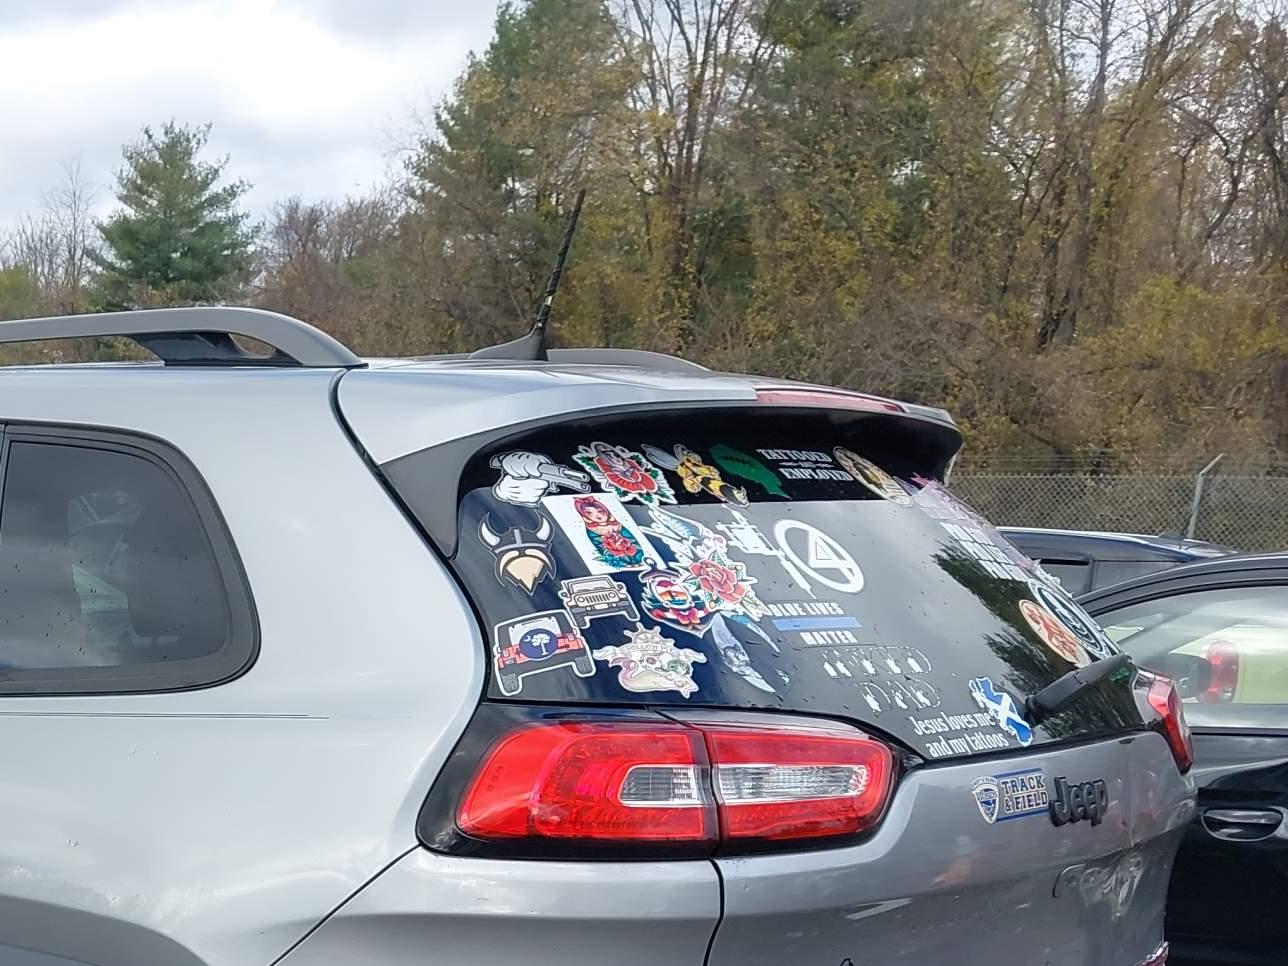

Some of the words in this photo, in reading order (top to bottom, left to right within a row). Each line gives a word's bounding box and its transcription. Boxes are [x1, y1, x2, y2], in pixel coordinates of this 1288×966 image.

[756, 448, 832, 463] TATTOOED
[777, 468, 855, 481] EMPLOYED
[799, 630, 859, 645] MATTER
[909, 716, 950, 736] Jesus
[940, 711, 976, 731] loves
[973, 712, 996, 727] me
[925, 735, 953, 758] and
[948, 737, 972, 755] my
[964, 731, 1010, 751] tattoos
[1000, 773, 1047, 796] TRACK
[1004, 796, 1014, 814] &
[1013, 790, 1049, 812] FIELD
[1049, 776, 1109, 827] Jeep
